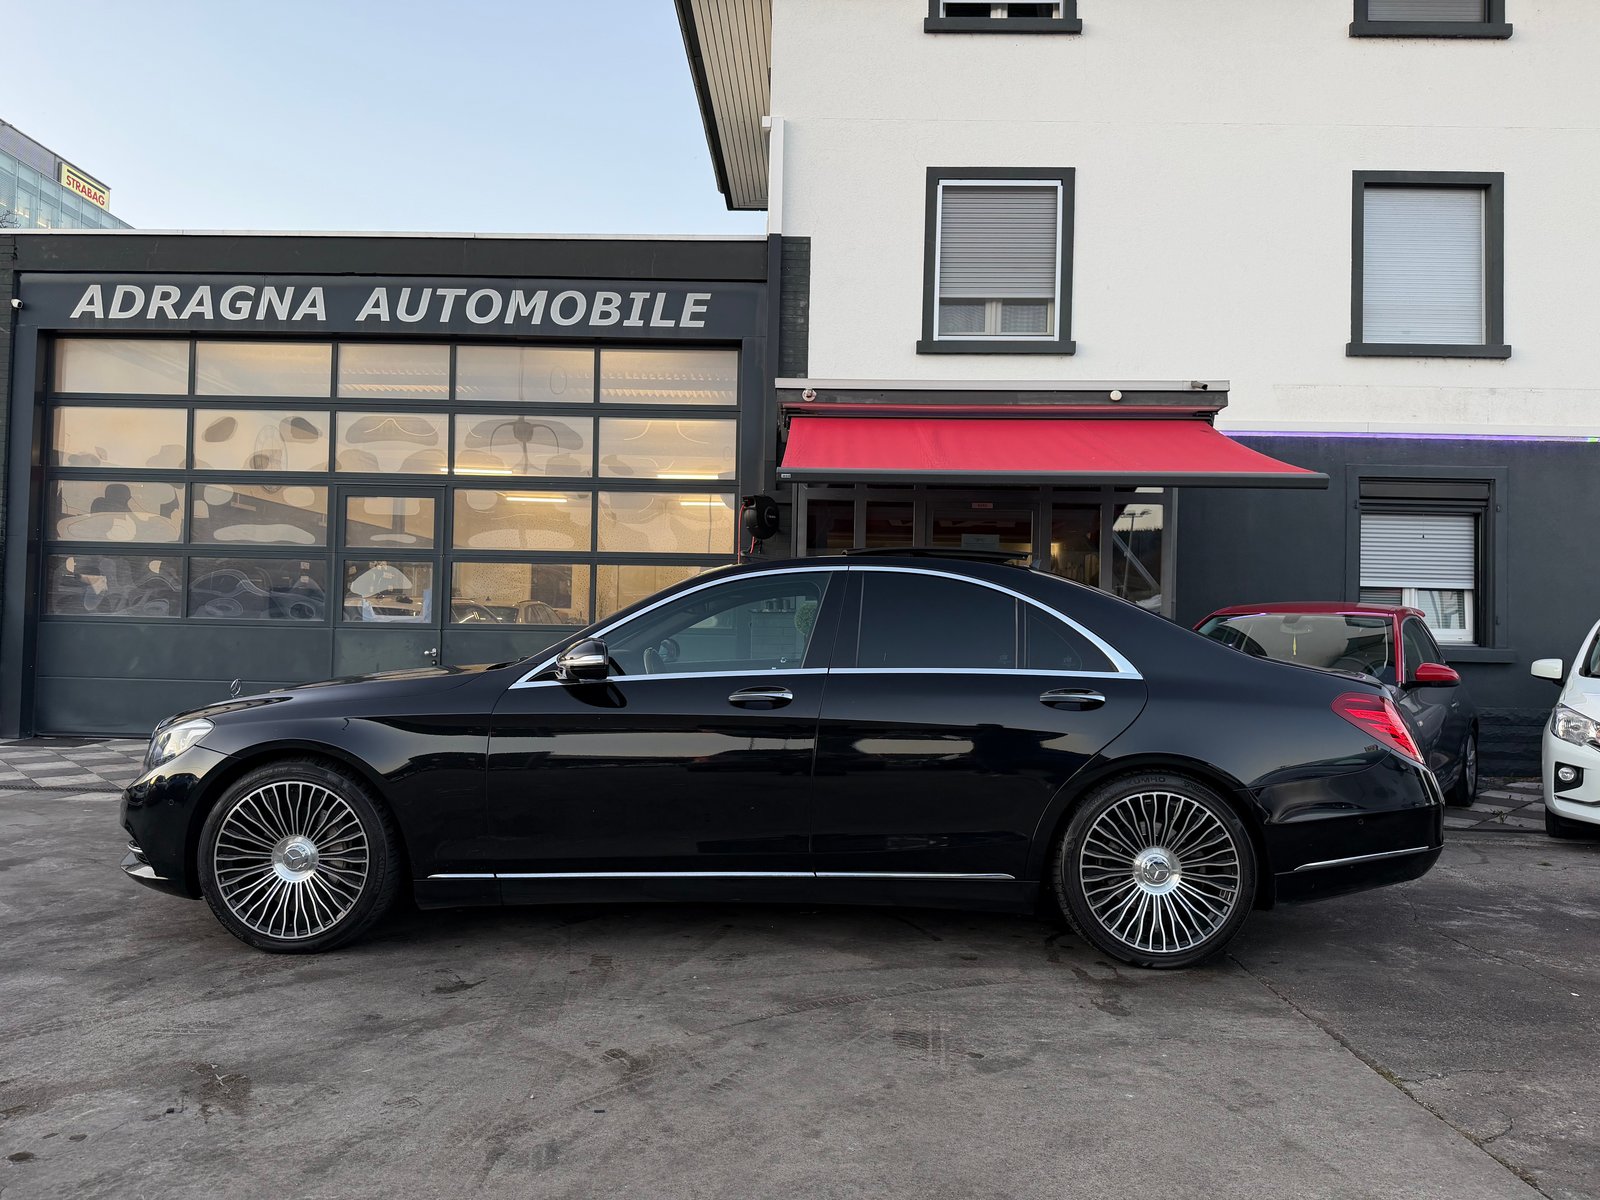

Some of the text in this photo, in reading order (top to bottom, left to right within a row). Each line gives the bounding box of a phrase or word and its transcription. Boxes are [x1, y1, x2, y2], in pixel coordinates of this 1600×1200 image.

[66, 175, 105, 206] STRABAG
[69, 284, 712, 328] ADRAGNA AUTOMOBILE
